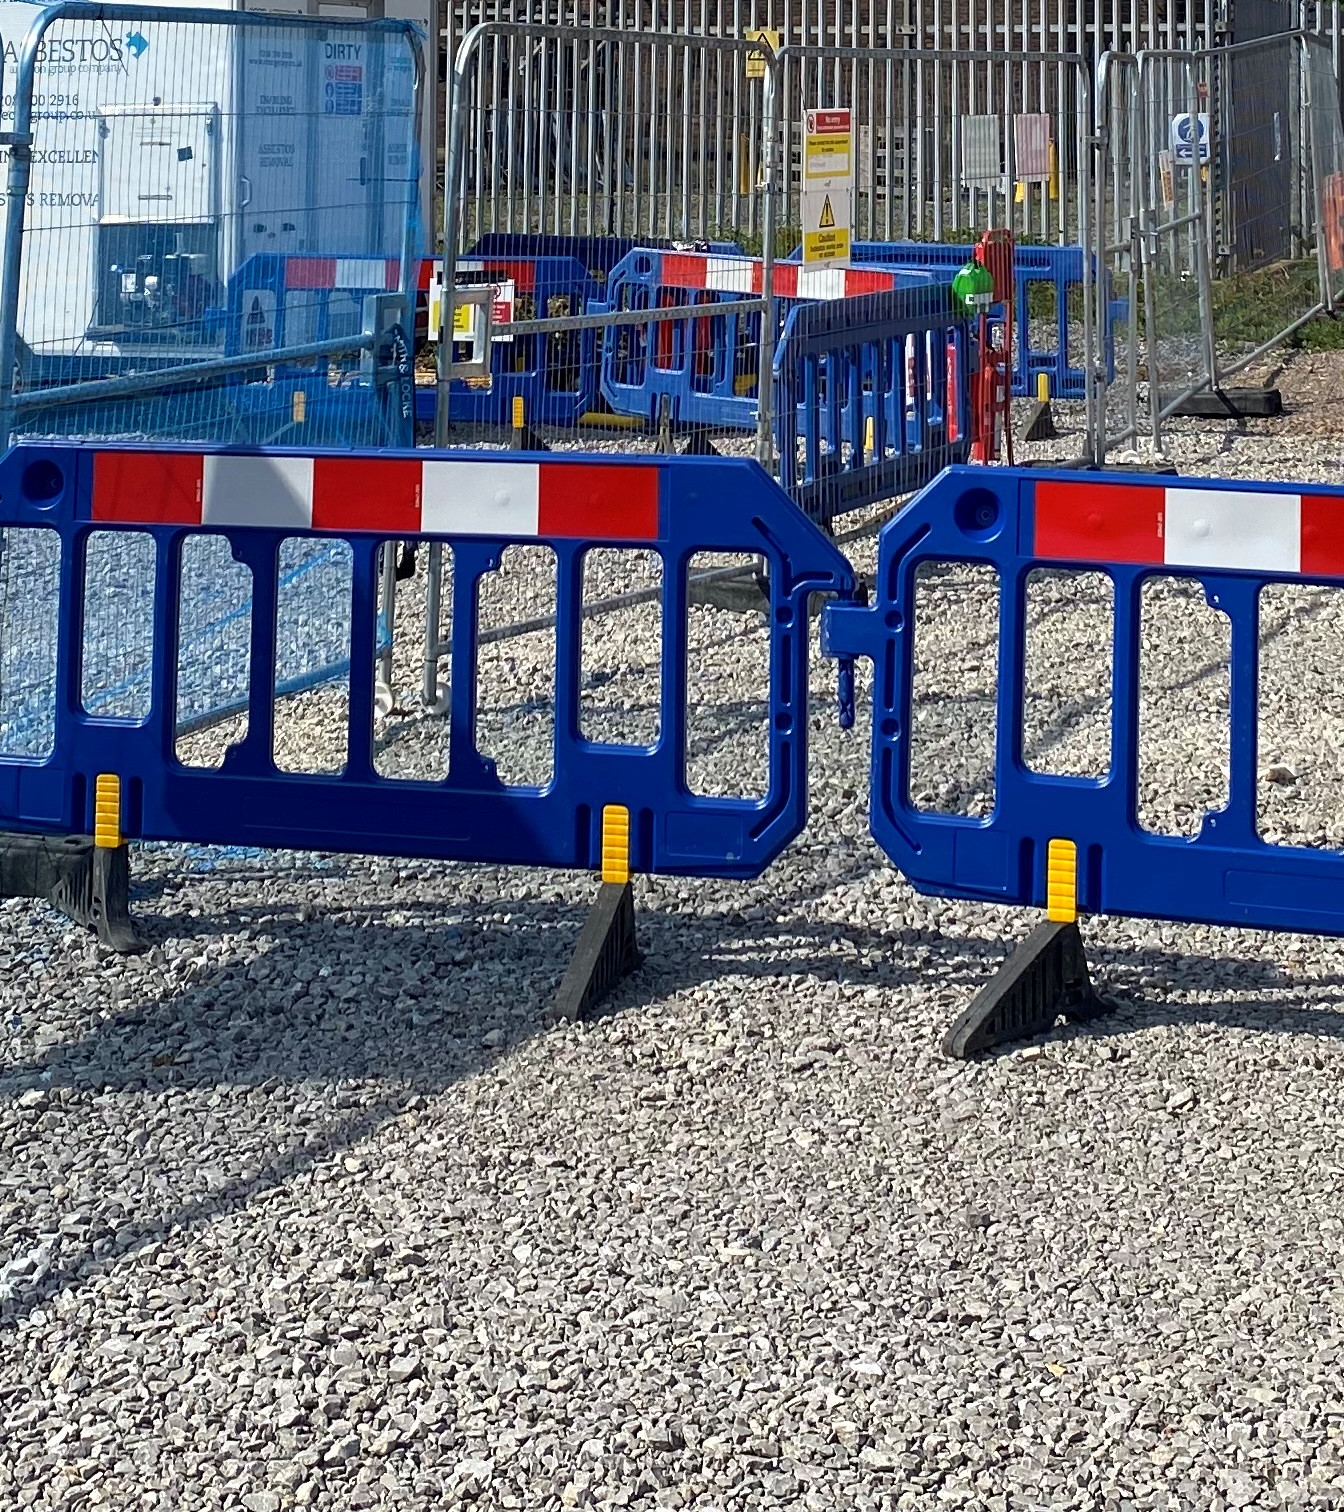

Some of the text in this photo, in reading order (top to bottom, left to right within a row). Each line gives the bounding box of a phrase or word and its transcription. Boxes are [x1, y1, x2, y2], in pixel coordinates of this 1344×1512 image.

[4, 38, 124, 63] ABESTOS
[325, 43, 362, 60] DIRTY
[48, 64, 76, 76] group
[78, 64, 123, 76] company
[50, 94, 78, 106] 2916
[30, 150, 99, 164] EXCELLEN
[40, 193, 99, 206] REMOVA
[400, 376, 413, 418] LOCKE
